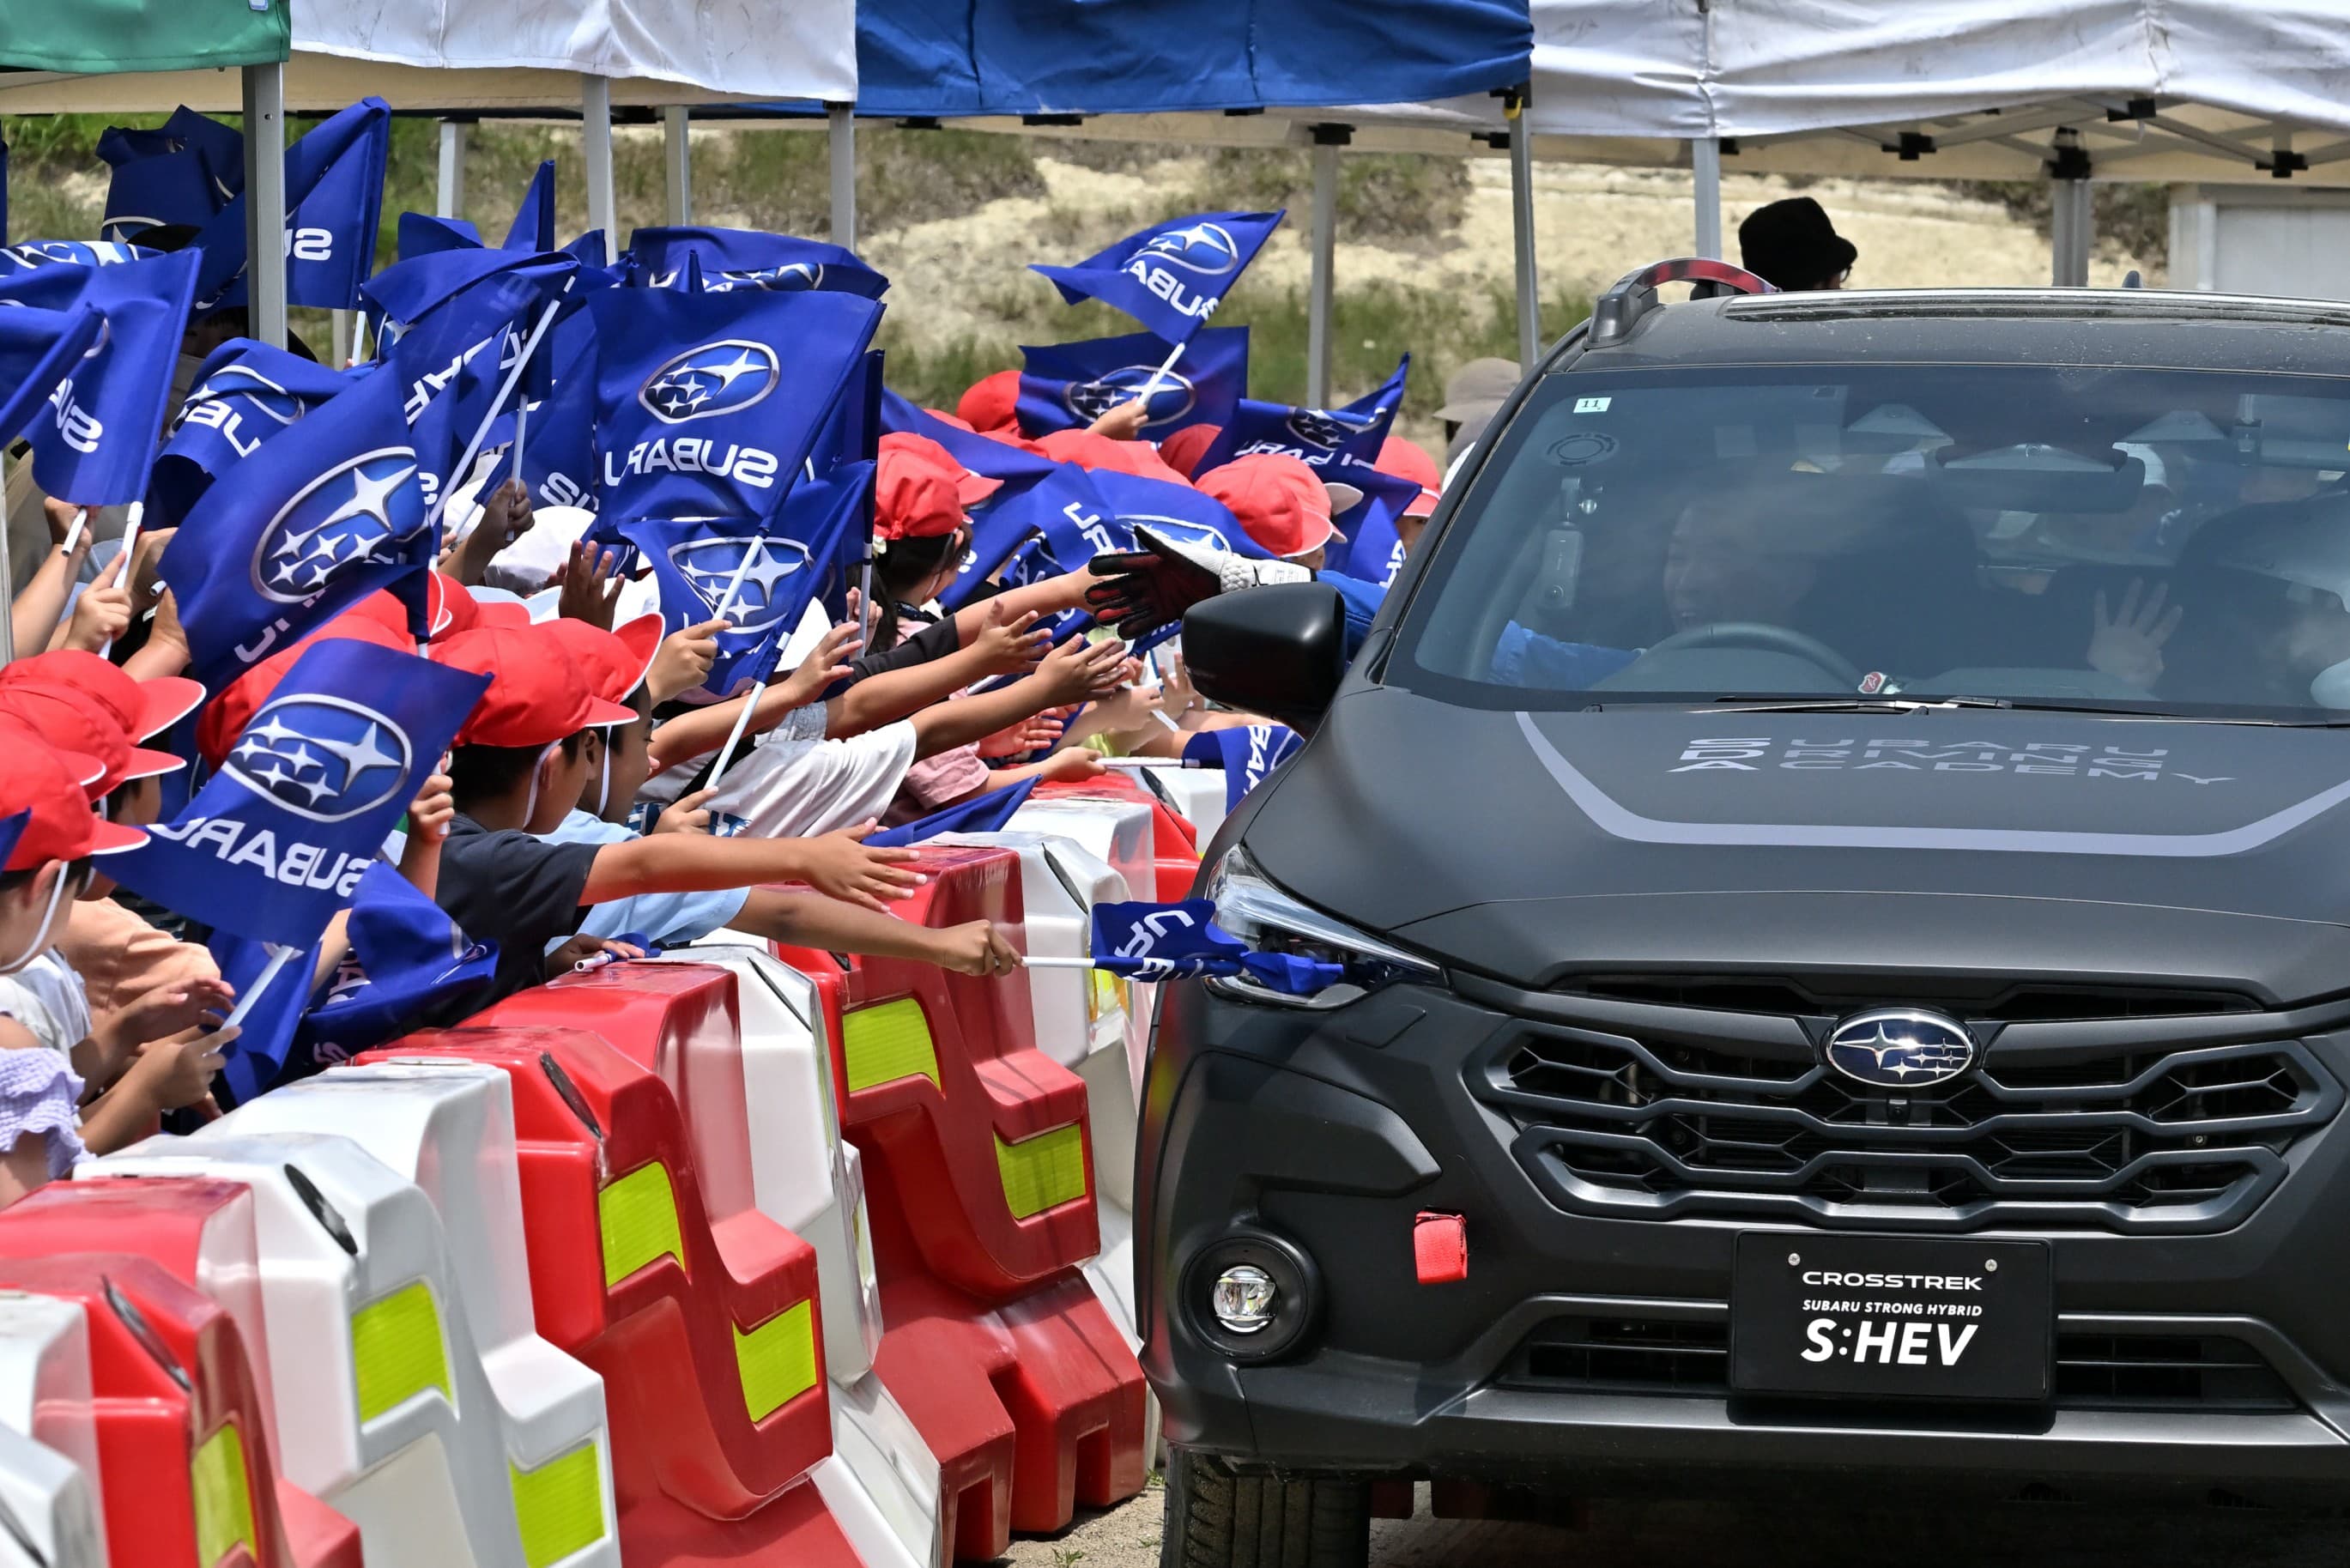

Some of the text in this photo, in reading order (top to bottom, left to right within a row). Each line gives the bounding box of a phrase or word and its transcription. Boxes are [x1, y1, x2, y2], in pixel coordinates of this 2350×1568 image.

[1688, 737, 2169, 756] SUBARU
[1680, 749, 2164, 769] DRIVING
[1665, 760, 2238, 784] ACADEMY
[1802, 1271, 1983, 1291] CROSSTREK
[1802, 1299, 1983, 1317] SUBARU STRONG HYBRID
[1801, 1317, 1979, 1366] S:HEV
